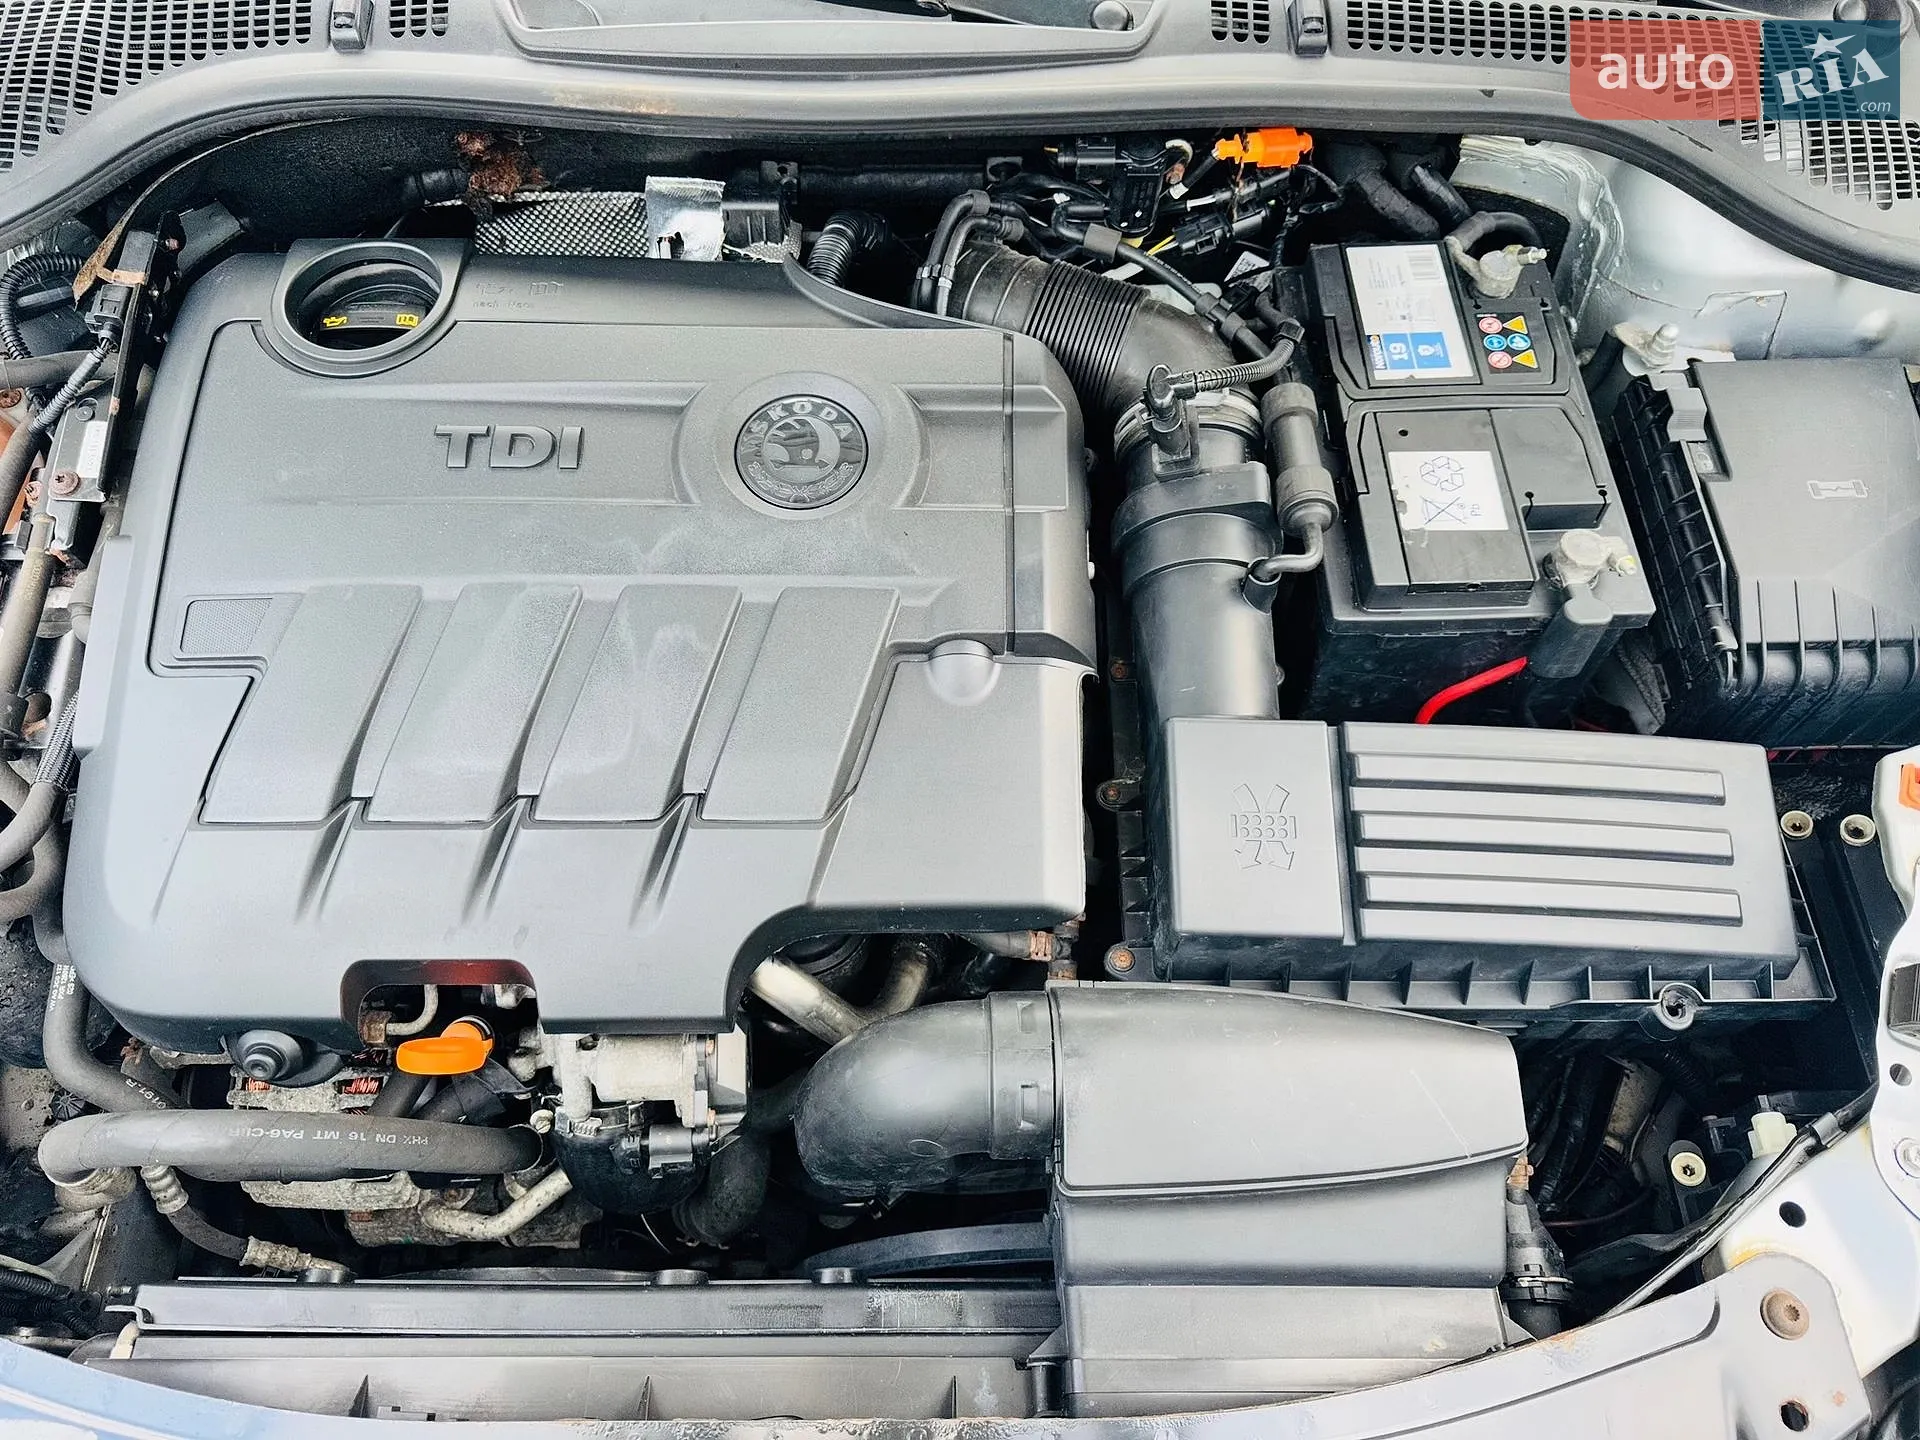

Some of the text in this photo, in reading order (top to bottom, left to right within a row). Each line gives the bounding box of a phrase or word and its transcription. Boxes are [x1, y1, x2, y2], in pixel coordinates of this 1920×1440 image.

[1389, 342, 1409, 360] 19
[434, 424, 585, 470] TDI
[312, 1129, 340, 1141] MT
[348, 1131, 367, 1142] 16
[375, 1133, 396, 1144] DN
